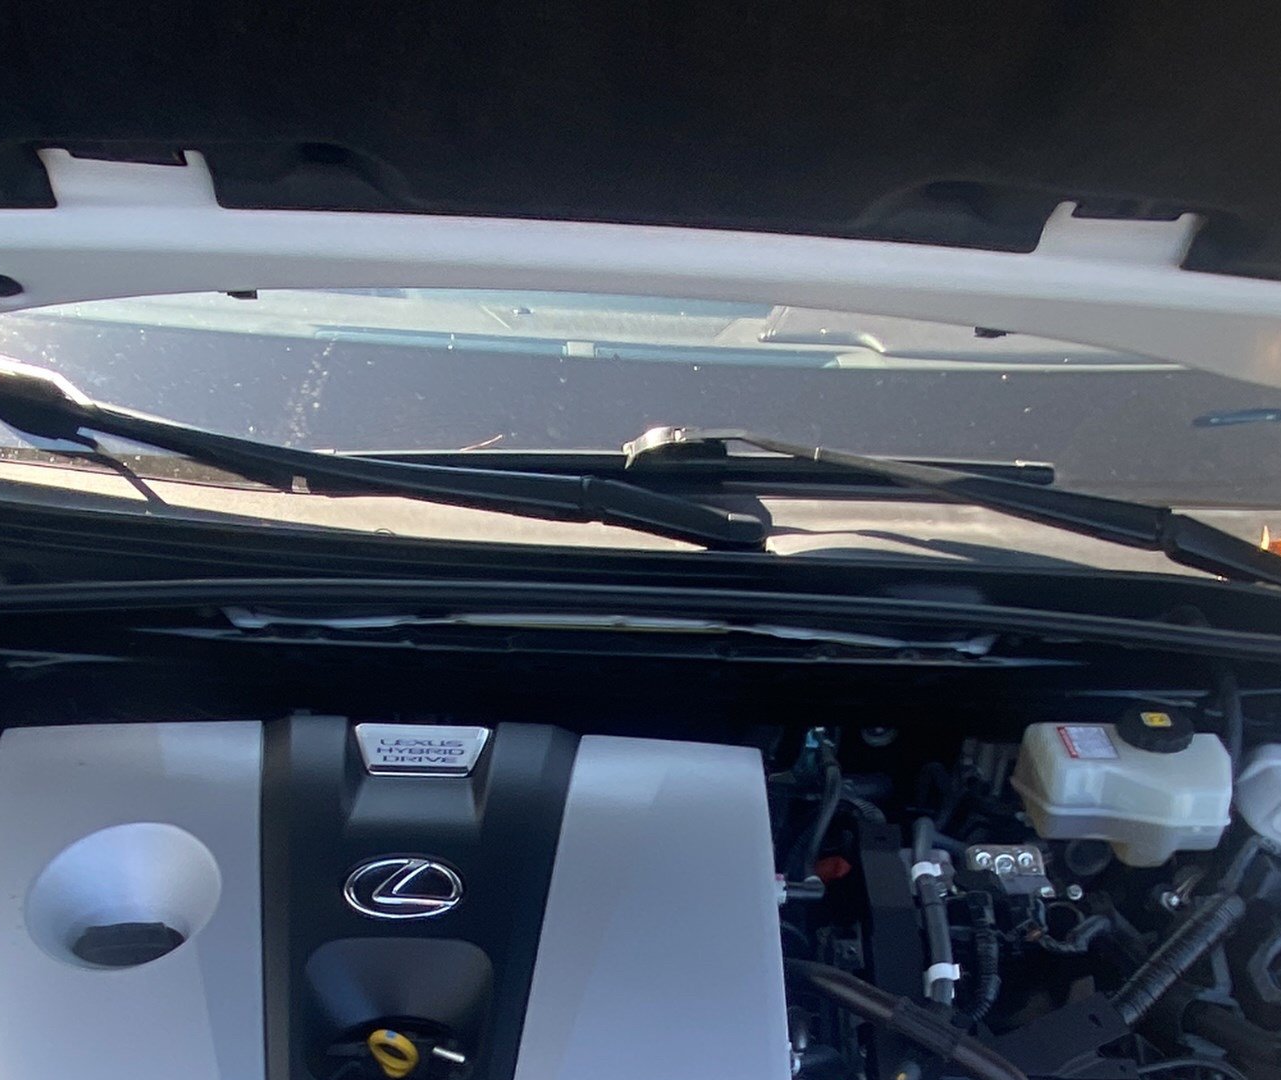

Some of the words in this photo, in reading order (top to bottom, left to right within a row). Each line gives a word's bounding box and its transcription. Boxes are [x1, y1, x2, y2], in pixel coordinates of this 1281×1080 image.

[380, 739, 463, 747] LEXUS
[376, 747, 465, 755] HYBRID
[382, 755, 458, 763] DRIVE
